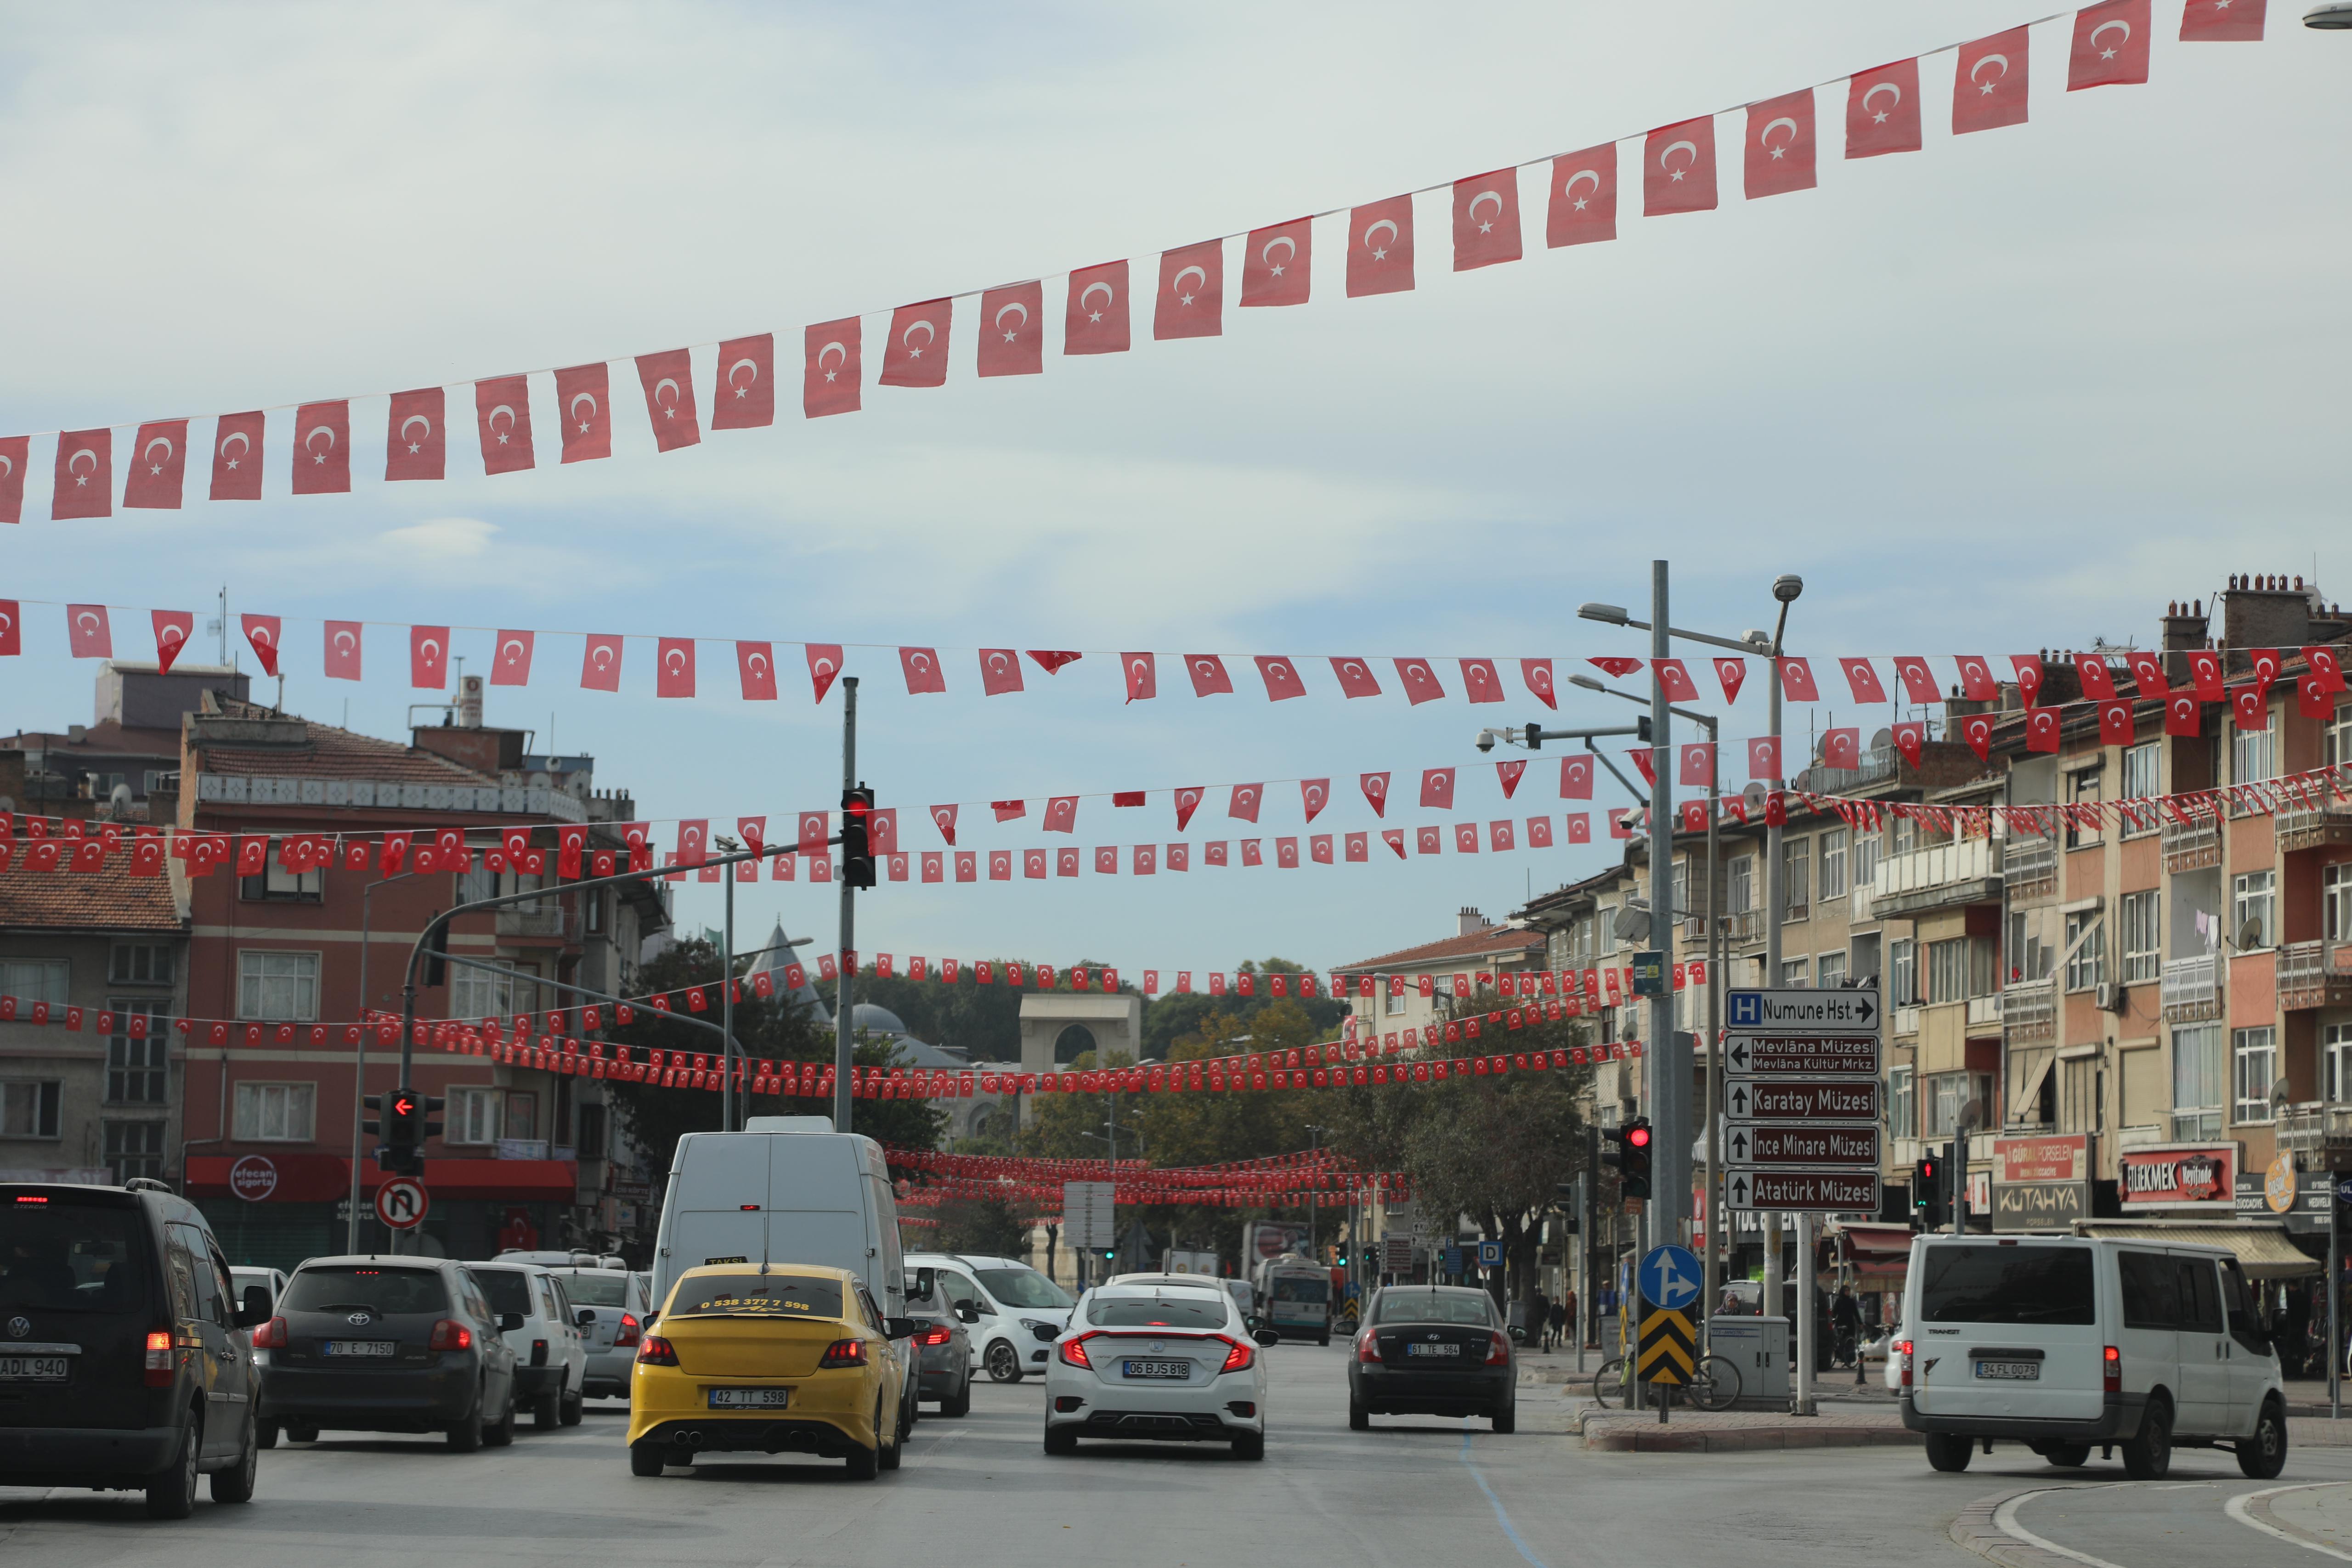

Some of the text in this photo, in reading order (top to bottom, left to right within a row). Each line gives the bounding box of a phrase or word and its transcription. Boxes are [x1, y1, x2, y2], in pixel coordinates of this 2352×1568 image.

[1737, 998, 1853, 1021] H Numune Hst.
[1821, 1039, 1874, 1054] Müzesi
[1804, 1058, 1839, 1069] Kültür
[1843, 1058, 1873, 1070] Mrkz.
[1754, 1089, 1873, 1116] Karatay Müzesi
[1754, 1128, 1873, 1156] İnce Minare Müzesi
[2012, 1144, 2037, 1163] GÜRAL
[2038, 1145, 2072, 1162] PORSELEN
[235, 1168, 272, 1178] efecan
[2182, 1165, 2212, 1187] Keyifzade
[237, 1178, 272, 1188] sigorta
[1755, 1179, 1874, 1202] Atatürk Müzesi
[1486, 1247, 1495, 1259] D
[785, 1301, 809, 1310] 598
[331, 1343, 391, 1354] 70 E 7150
[1412, 1345, 1458, 1354] 61 TE 564
[0, 1359, 65, 1375] ADL 940
[1130, 1363, 1187, 1375] 06 BJS 818
[1983, 1364, 2035, 1375] 34 FL 0079
[717, 1391, 731, 1403] 42
[741, 1391, 754, 1402] TT
[763, 1391, 785, 1403] 598
